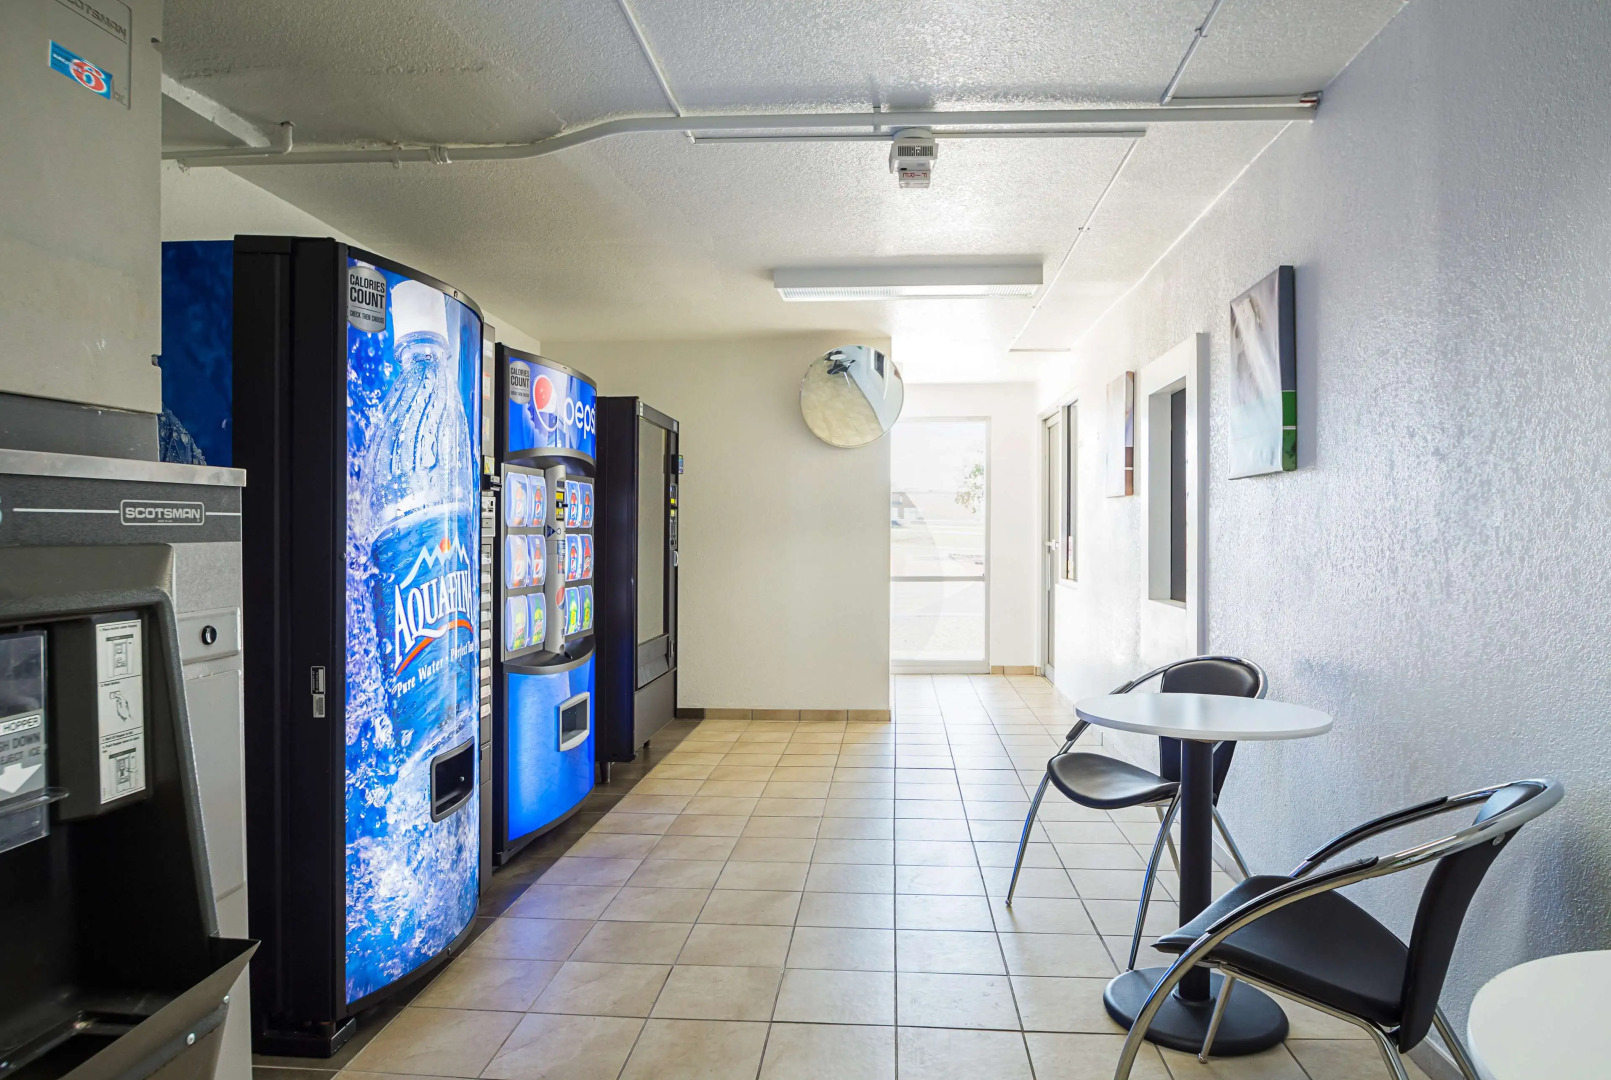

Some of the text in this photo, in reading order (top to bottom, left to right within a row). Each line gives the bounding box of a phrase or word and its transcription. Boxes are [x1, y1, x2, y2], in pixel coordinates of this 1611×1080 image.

[350, 273, 385, 294] CALORIES
[350, 286, 385, 309] COUNT
[510, 367, 530, 378] CALORIES
[510, 375, 530, 388] COUNT
[125, 507, 200, 519] SCOTSMAN
[395, 570, 473, 672] AQUAFINA
[395, 676, 416, 698] Pure
[418, 658, 444, 683] Water
[3, 716, 39, 732] HOPPER
[12, 732, 41, 749] DOWN
[28, 746, 41, 757] ICE
